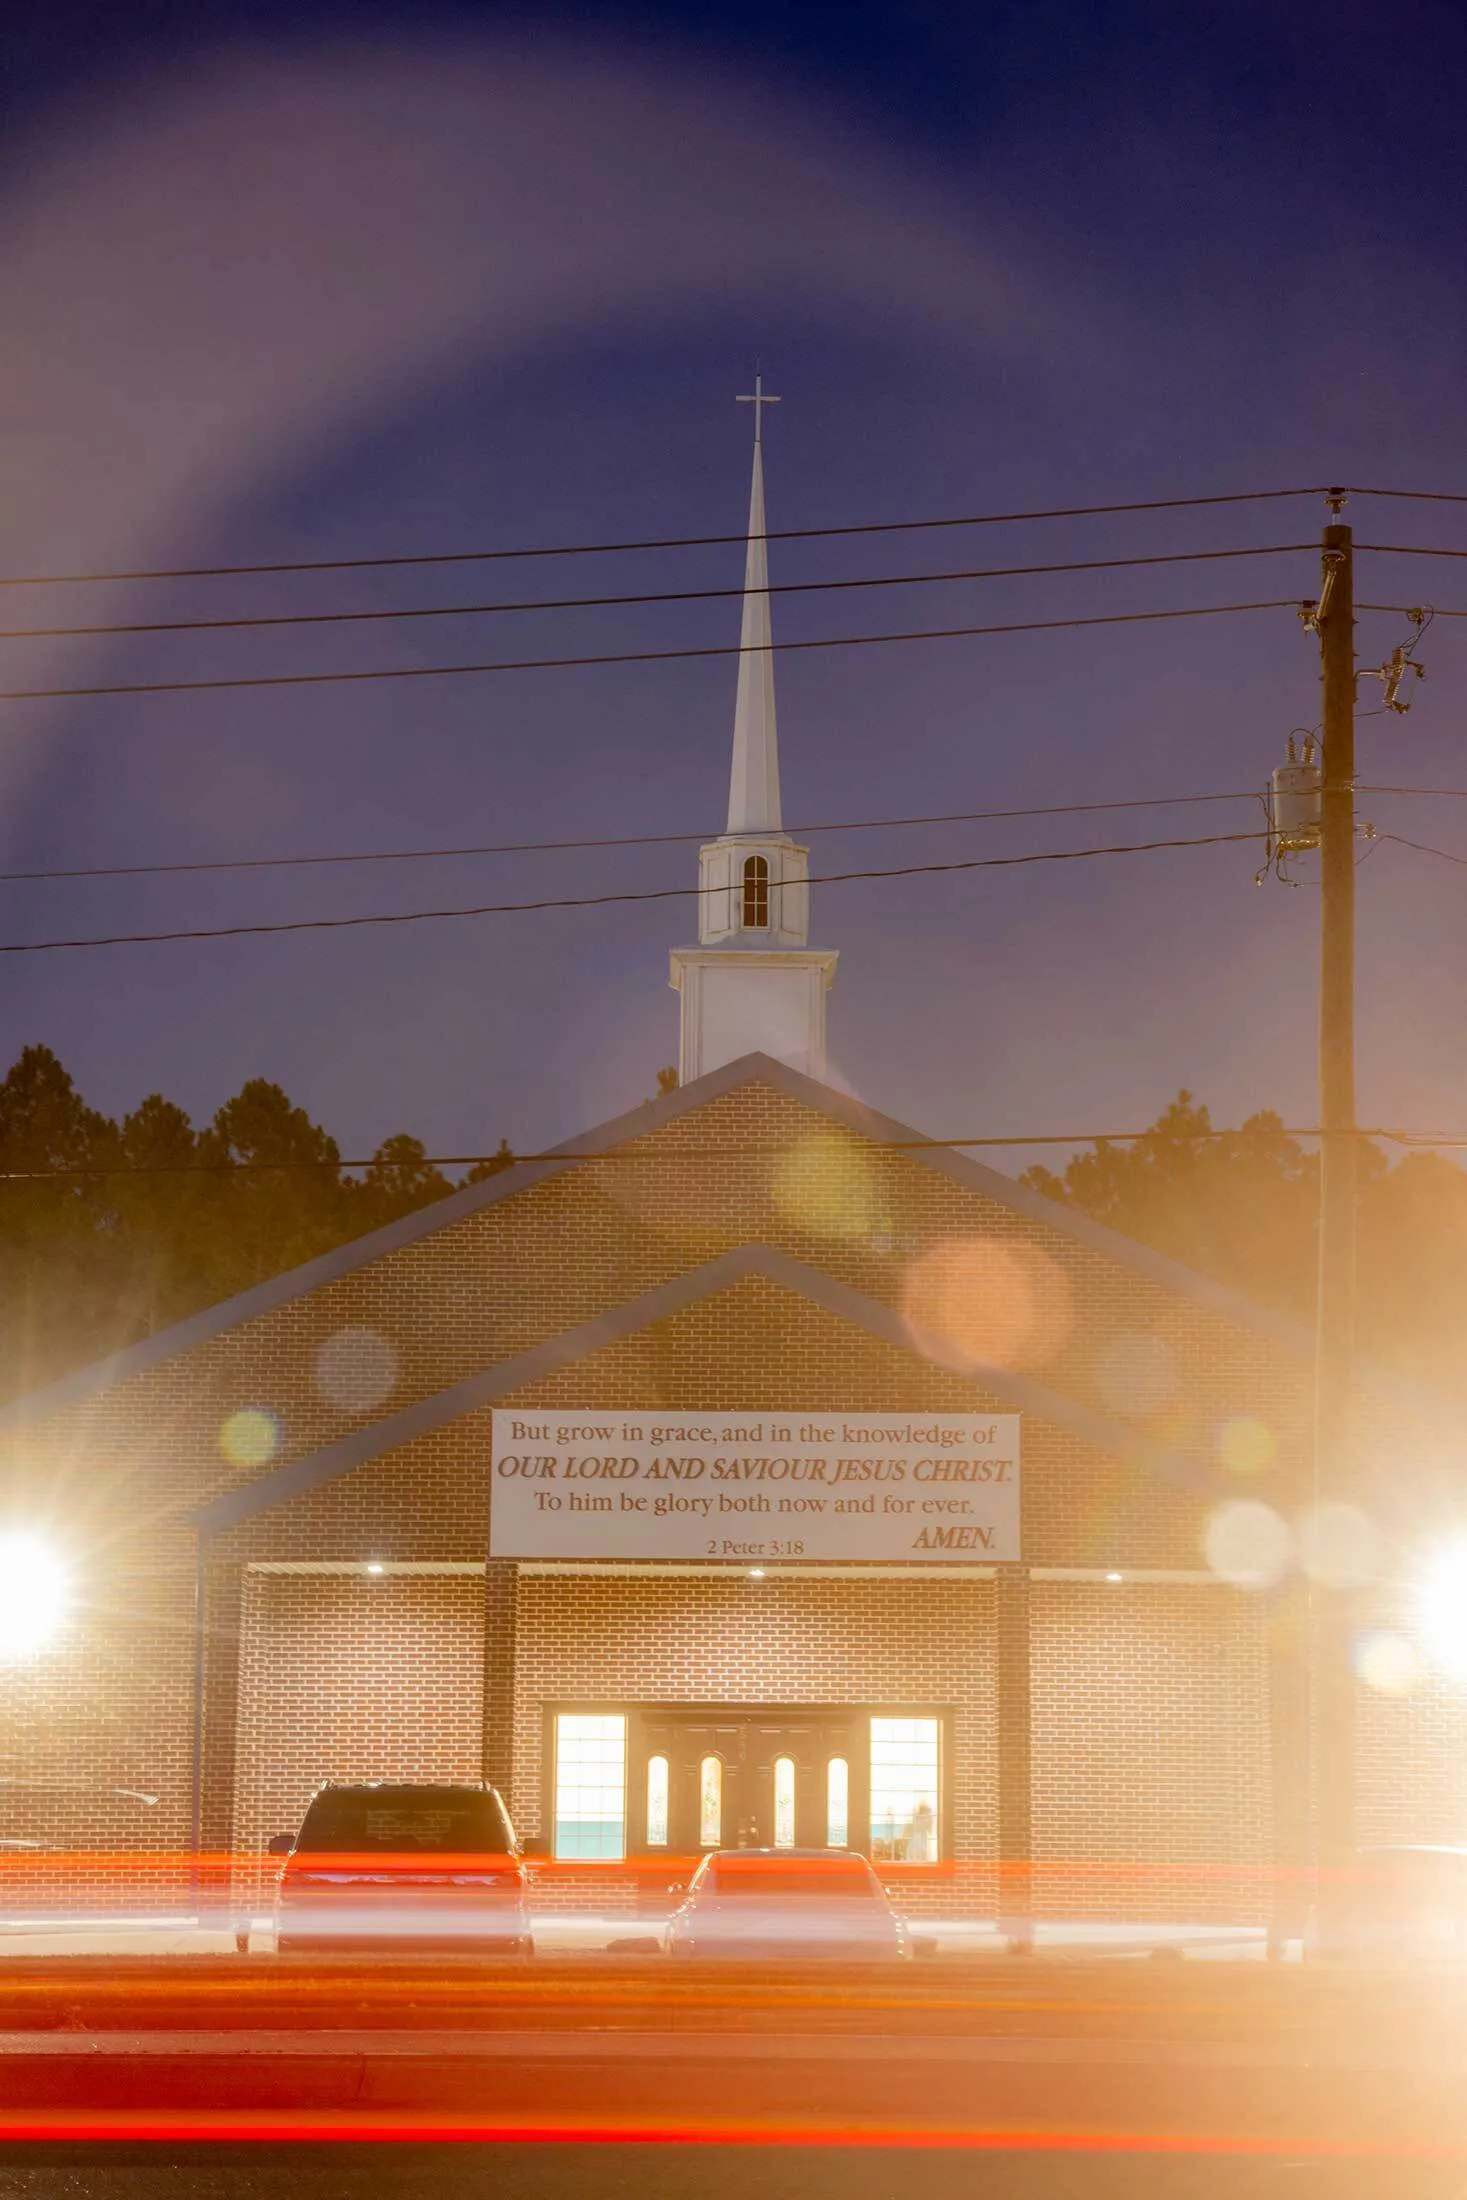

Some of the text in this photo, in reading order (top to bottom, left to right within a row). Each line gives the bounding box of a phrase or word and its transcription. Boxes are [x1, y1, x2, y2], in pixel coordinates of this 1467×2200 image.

[511, 1421, 998, 1448] But grow in grace, and in the knowledge of
[497, 1455, 1013, 1486] OUR LORD AND SAVIOUR JESUS CHRIST.
[533, 1491, 976, 1517] To him be glory both now and for ever.
[707, 1539, 805, 1555] 2 Peter 3:18
[911, 1526, 997, 1549] AMEN.
